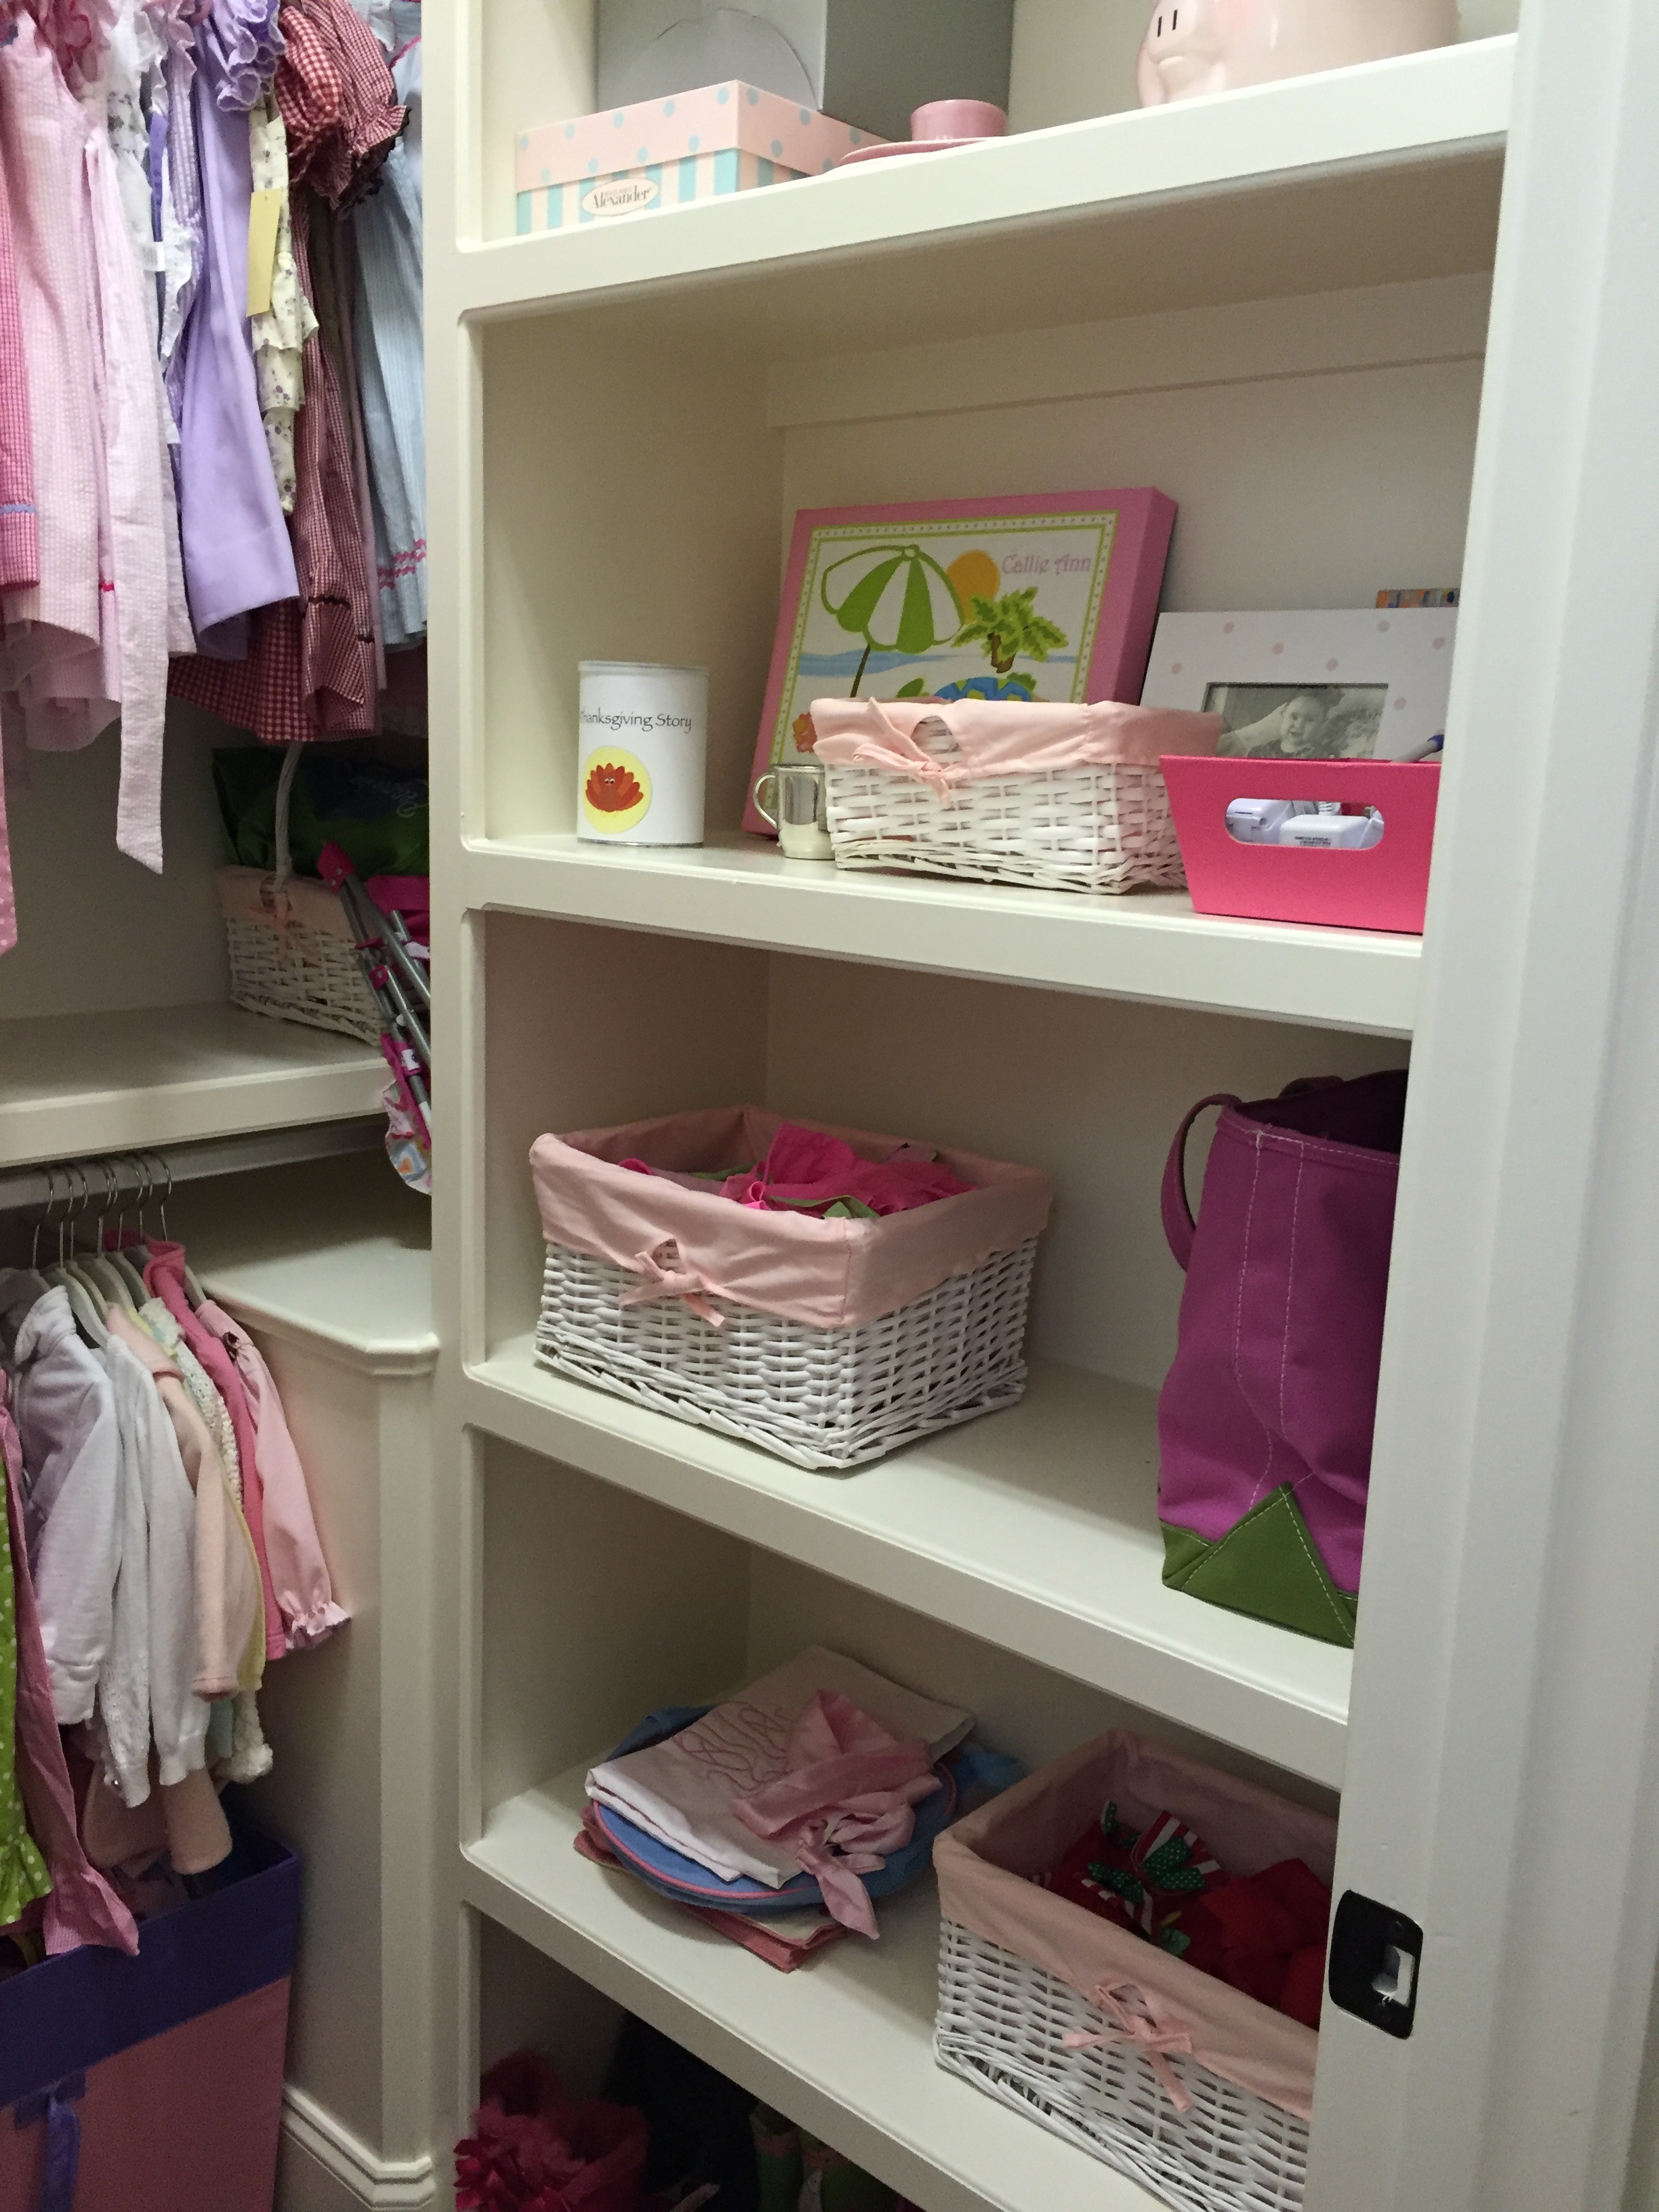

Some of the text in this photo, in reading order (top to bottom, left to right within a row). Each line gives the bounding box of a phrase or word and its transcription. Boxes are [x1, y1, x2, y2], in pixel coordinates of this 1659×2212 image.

[593, 185, 652, 209] Alexander
[1002, 554, 1092, 575] Callie Ann
[655, 713, 692, 734] Story
